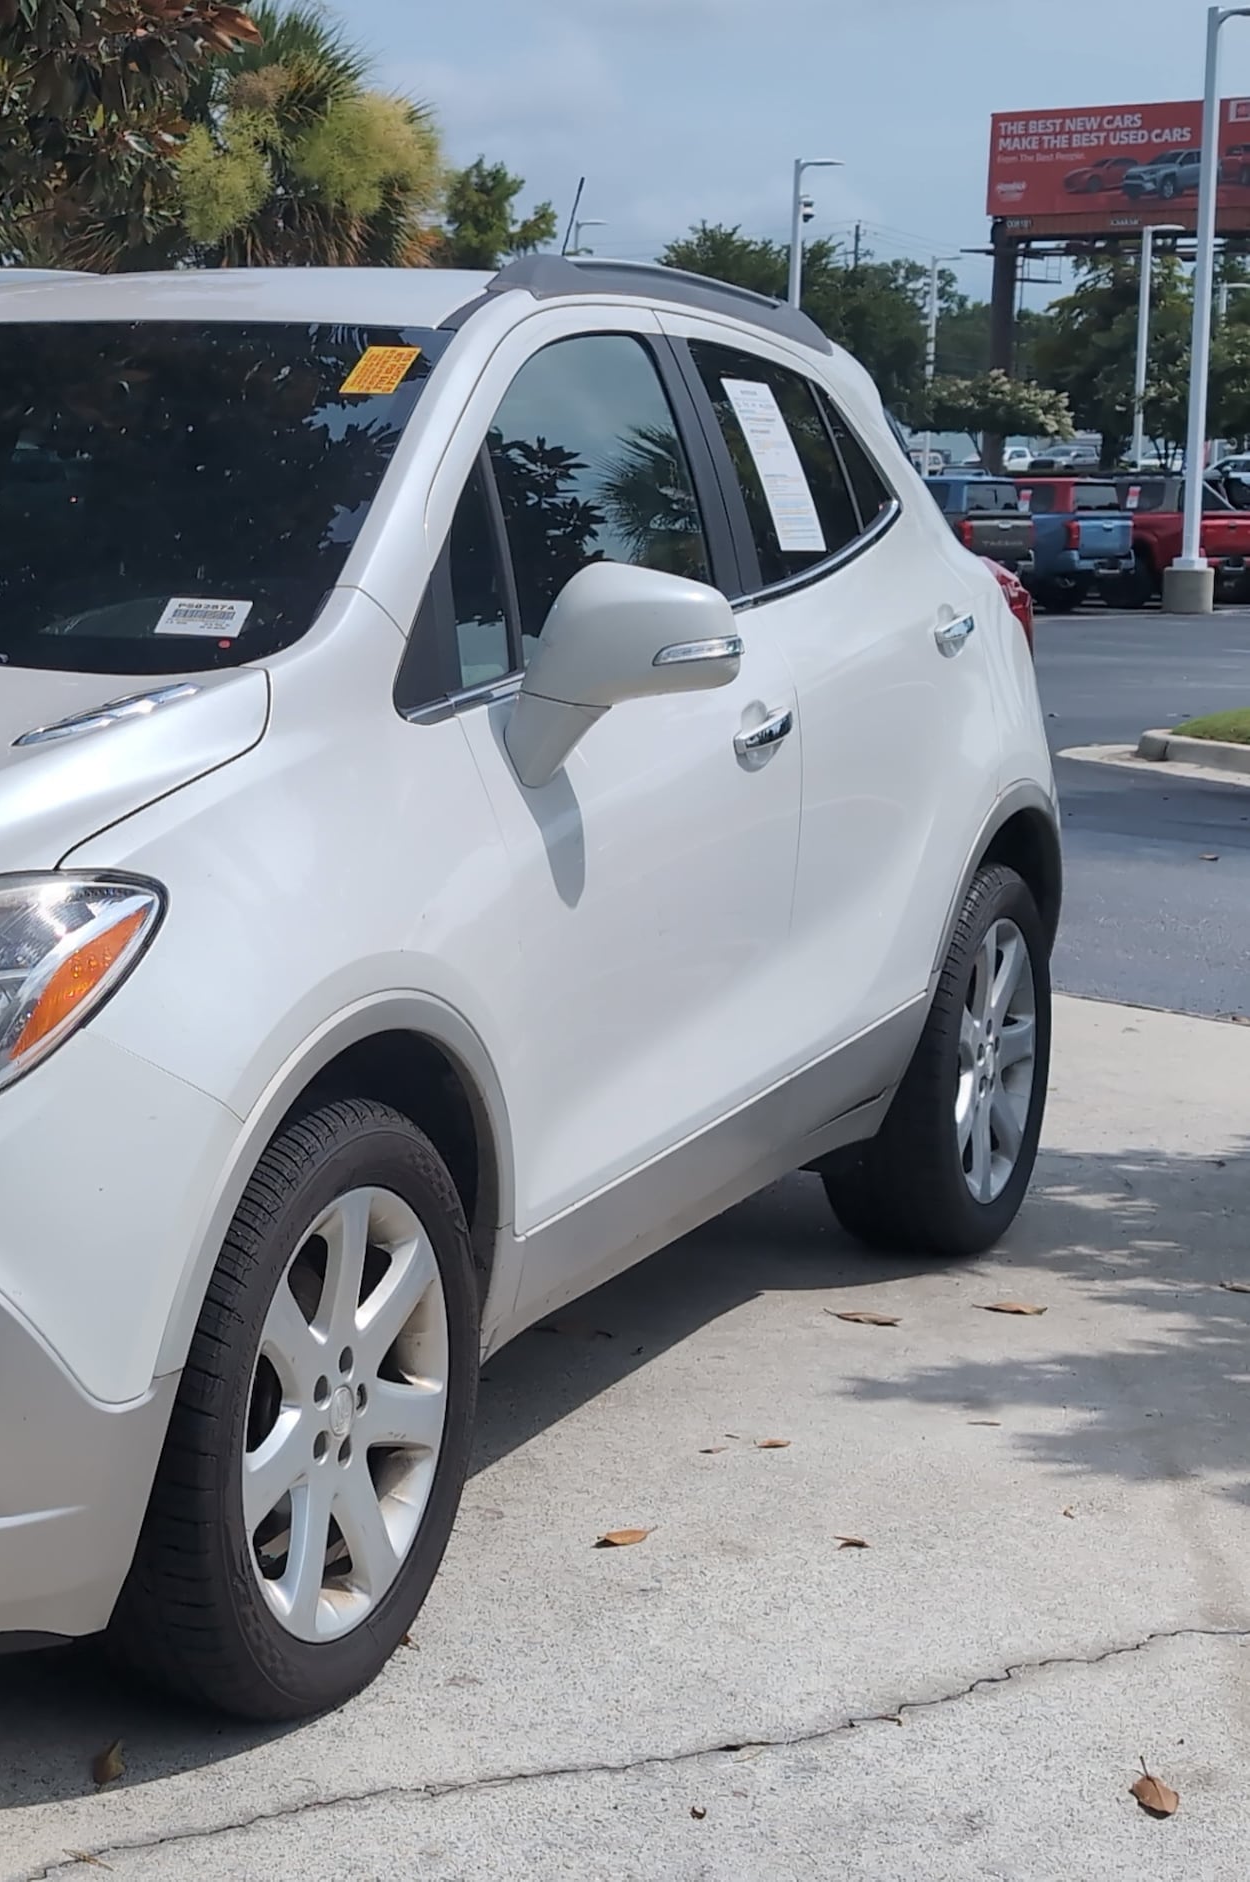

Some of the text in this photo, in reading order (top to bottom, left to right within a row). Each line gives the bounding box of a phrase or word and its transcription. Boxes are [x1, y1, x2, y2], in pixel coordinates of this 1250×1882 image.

[999, 113, 1142, 136] THE BEST NEW CARS
[998, 127, 1191, 151] MAKE THE BEST USED CARS
[1020, 153, 1035, 162] The
[1036, 152, 1054, 162] Best
